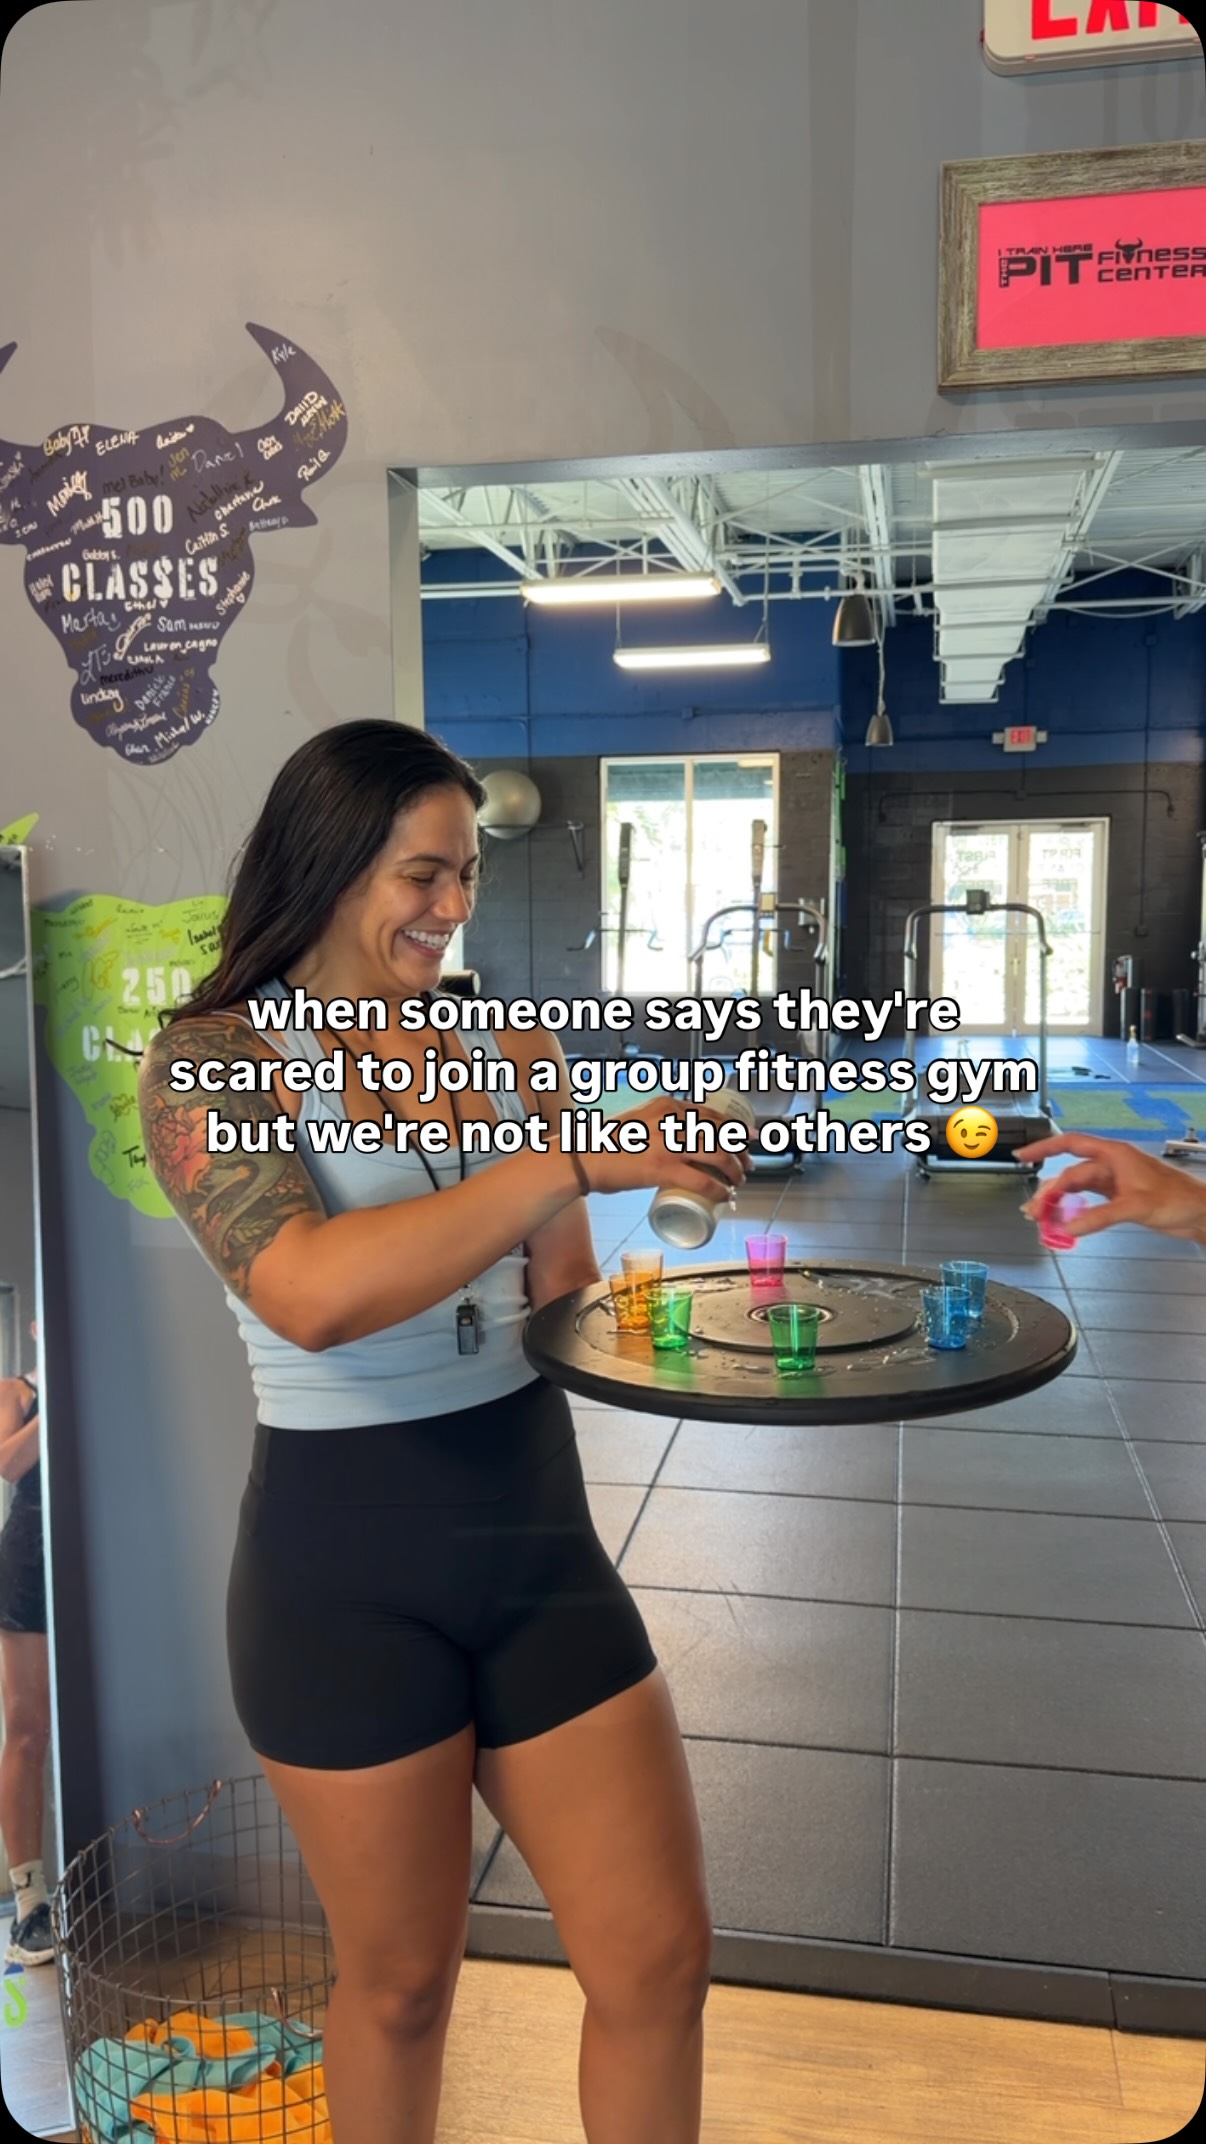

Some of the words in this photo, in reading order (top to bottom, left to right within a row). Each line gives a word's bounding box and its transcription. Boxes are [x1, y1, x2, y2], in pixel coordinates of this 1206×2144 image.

[1000, 252, 1093, 288] PIT
[271, 344, 297, 364] Kyle
[95, 431, 140, 456] ELENA
[102, 494, 174, 539] 500
[62, 556, 218, 602] CLASSES
[157, 616, 187, 632] Sam
[122, 966, 193, 1007] 250
